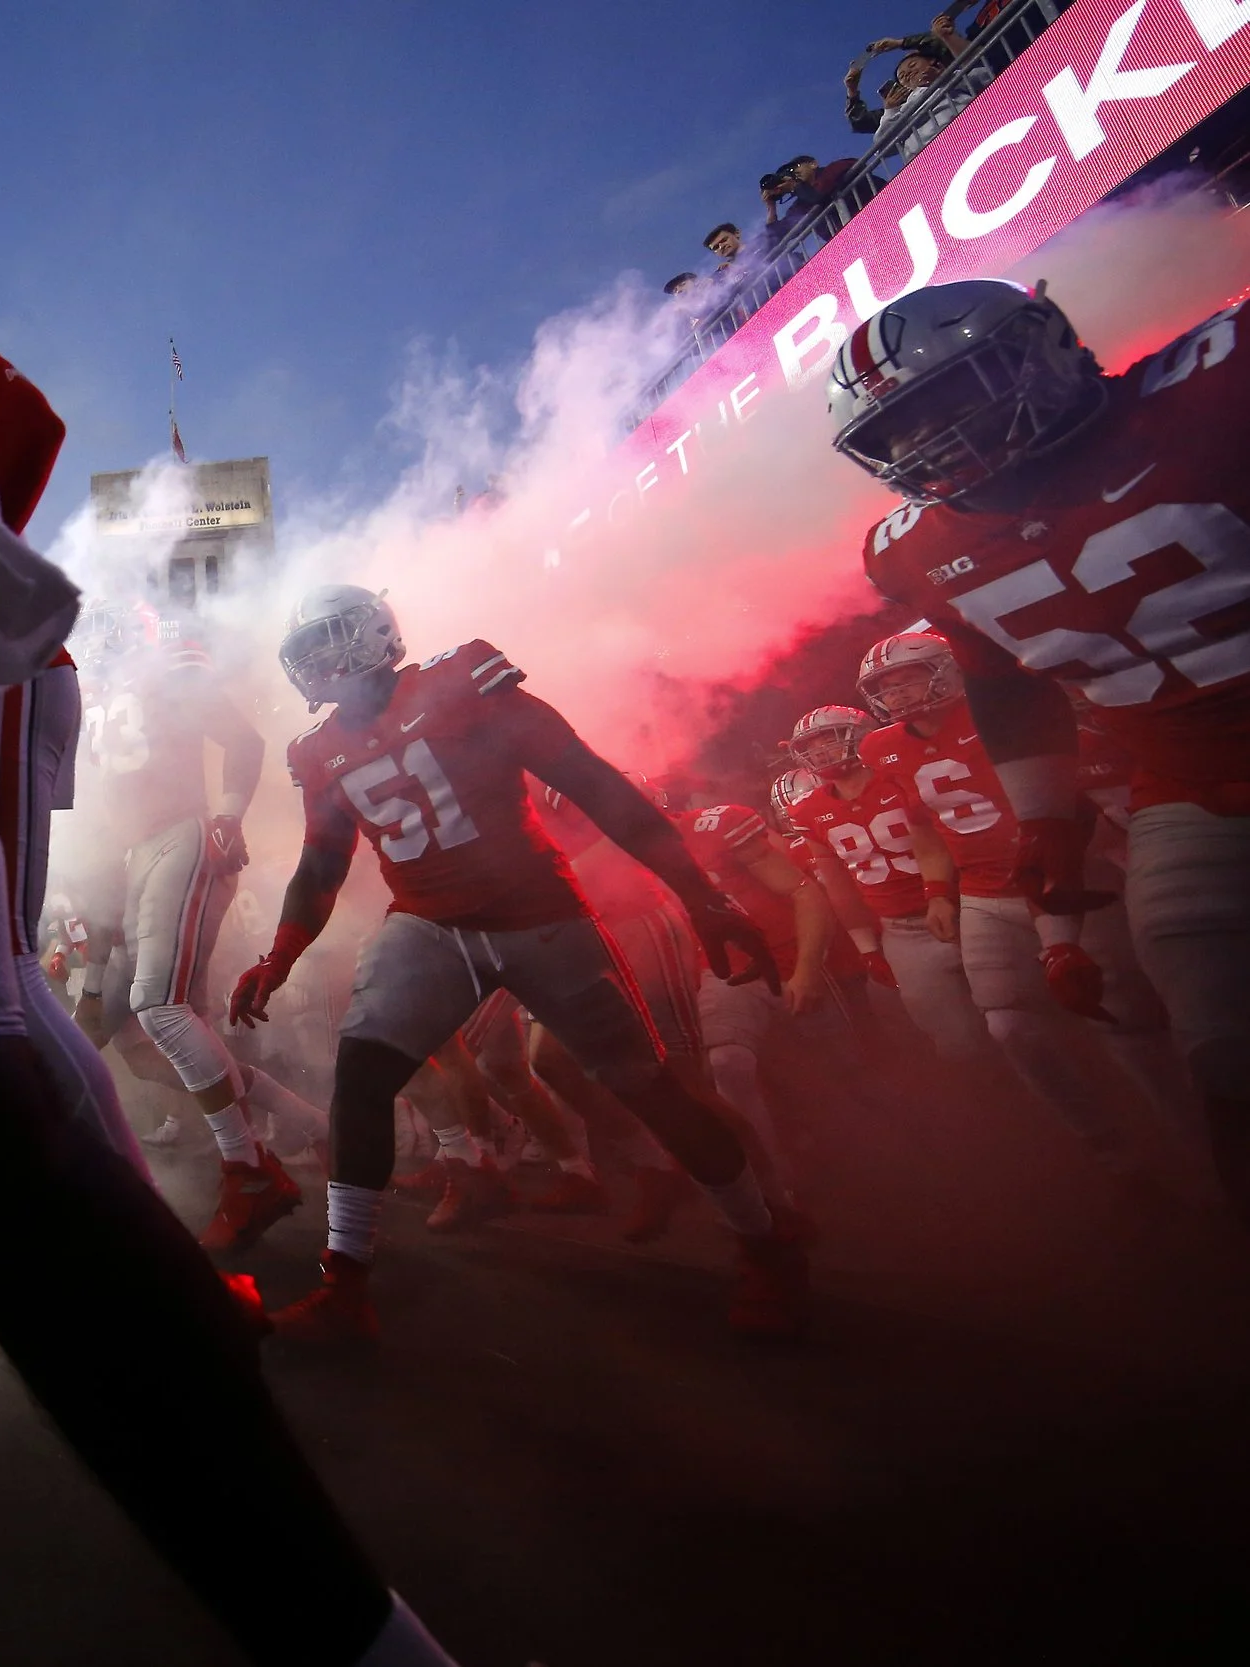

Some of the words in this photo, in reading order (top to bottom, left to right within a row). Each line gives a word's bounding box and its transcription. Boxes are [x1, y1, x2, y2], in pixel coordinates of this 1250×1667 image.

[186, 516, 221, 527] Center
[205, 500, 252, 513] Wolstein
[947, 503, 1250, 707] 52
[339, 737, 481, 863] 51
[913, 758, 1002, 834] 6
[827, 807, 922, 885] 89
